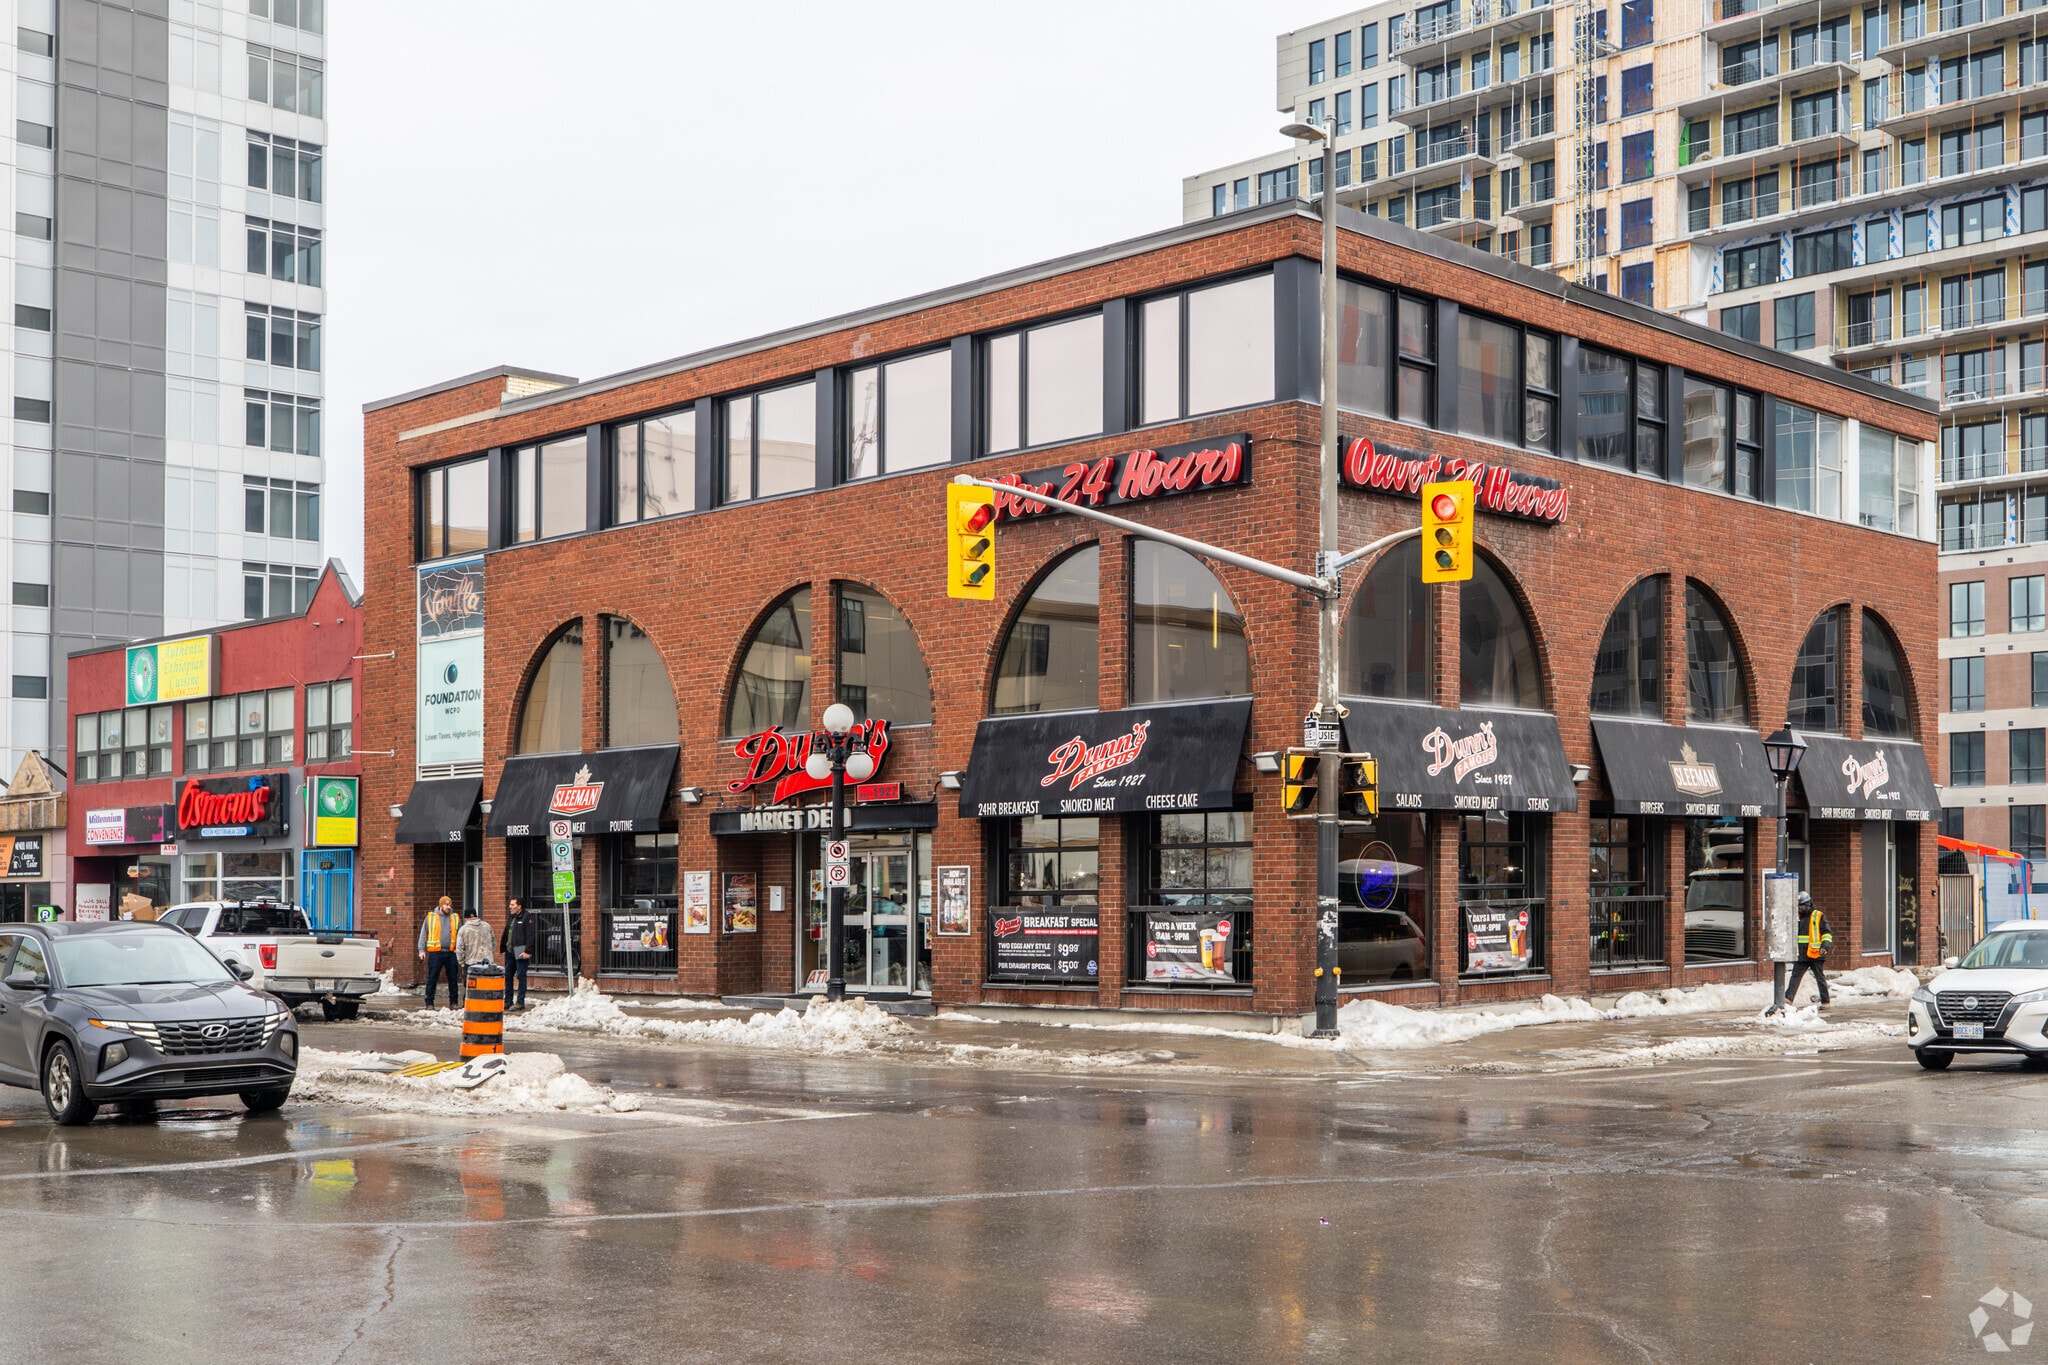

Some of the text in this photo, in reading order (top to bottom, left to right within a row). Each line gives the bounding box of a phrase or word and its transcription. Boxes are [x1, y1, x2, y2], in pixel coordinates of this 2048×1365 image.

[980, 442, 1242, 520] pen 24 Hours
[1344, 437, 1442, 493] Ouvert
[1482, 466, 1569, 522] Heures
[426, 576, 480, 621] Vanilla
[425, 689, 481, 706] FOUNDATION
[1318, 731, 1334, 740] USIE
[1041, 720, 1151, 787] Dunn's
[1422, 721, 1497, 776] Dunn's
[1078, 750, 1135, 782] FAMOUS
[1457, 751, 1495, 774] FAMOUS
[1093, 774, 1145, 788] Since 1927
[1474, 773, 1512, 785] Since 1927
[1674, 767, 1718, 787] SLEEMAN
[553, 787, 599, 807] SLEEMAN
[873, 786, 897, 798] 1927
[1060, 797, 1115, 812] SMOKED MEAT
[1146, 793, 1198, 809] CHEESE CAKE
[1396, 794, 1422, 808] SALADS
[1454, 795, 1498, 810] SMOKED MEAT
[1528, 798, 1549, 811] STEAKS
[978, 801, 1039, 816] 24HR BREAKFAST
[1640, 802, 1664, 814] BURGERS
[1685, 803, 1720, 815] SMOKED MEAT
[1741, 805, 1762, 816] POUTINE
[1833, 808, 1856, 818] BREAKFAST
[1864, 808, 1892, 819] SMOKED MEAT
[89, 812, 122, 824] Millennium
[740, 808, 852, 831] MARKET DEI
[1905, 810, 1919, 820] CHEESE
[507, 825, 529, 836] BURGERS
[572, 822, 586, 832] MEAT
[610, 820, 633, 832] POUTINE
[87, 828, 123, 841] CONVENIENCE
[449, 831, 461, 841] 353
[1024, 917, 1098, 928] BREAKFAST SPECIAL
[1472, 914, 1487, 923] DAYS
[1490, 914, 1506, 922] WEEK
[1154, 922, 1170, 930] DAYS
[1171, 922, 1175, 930] A
[1175, 922, 1197, 930] WEEK
